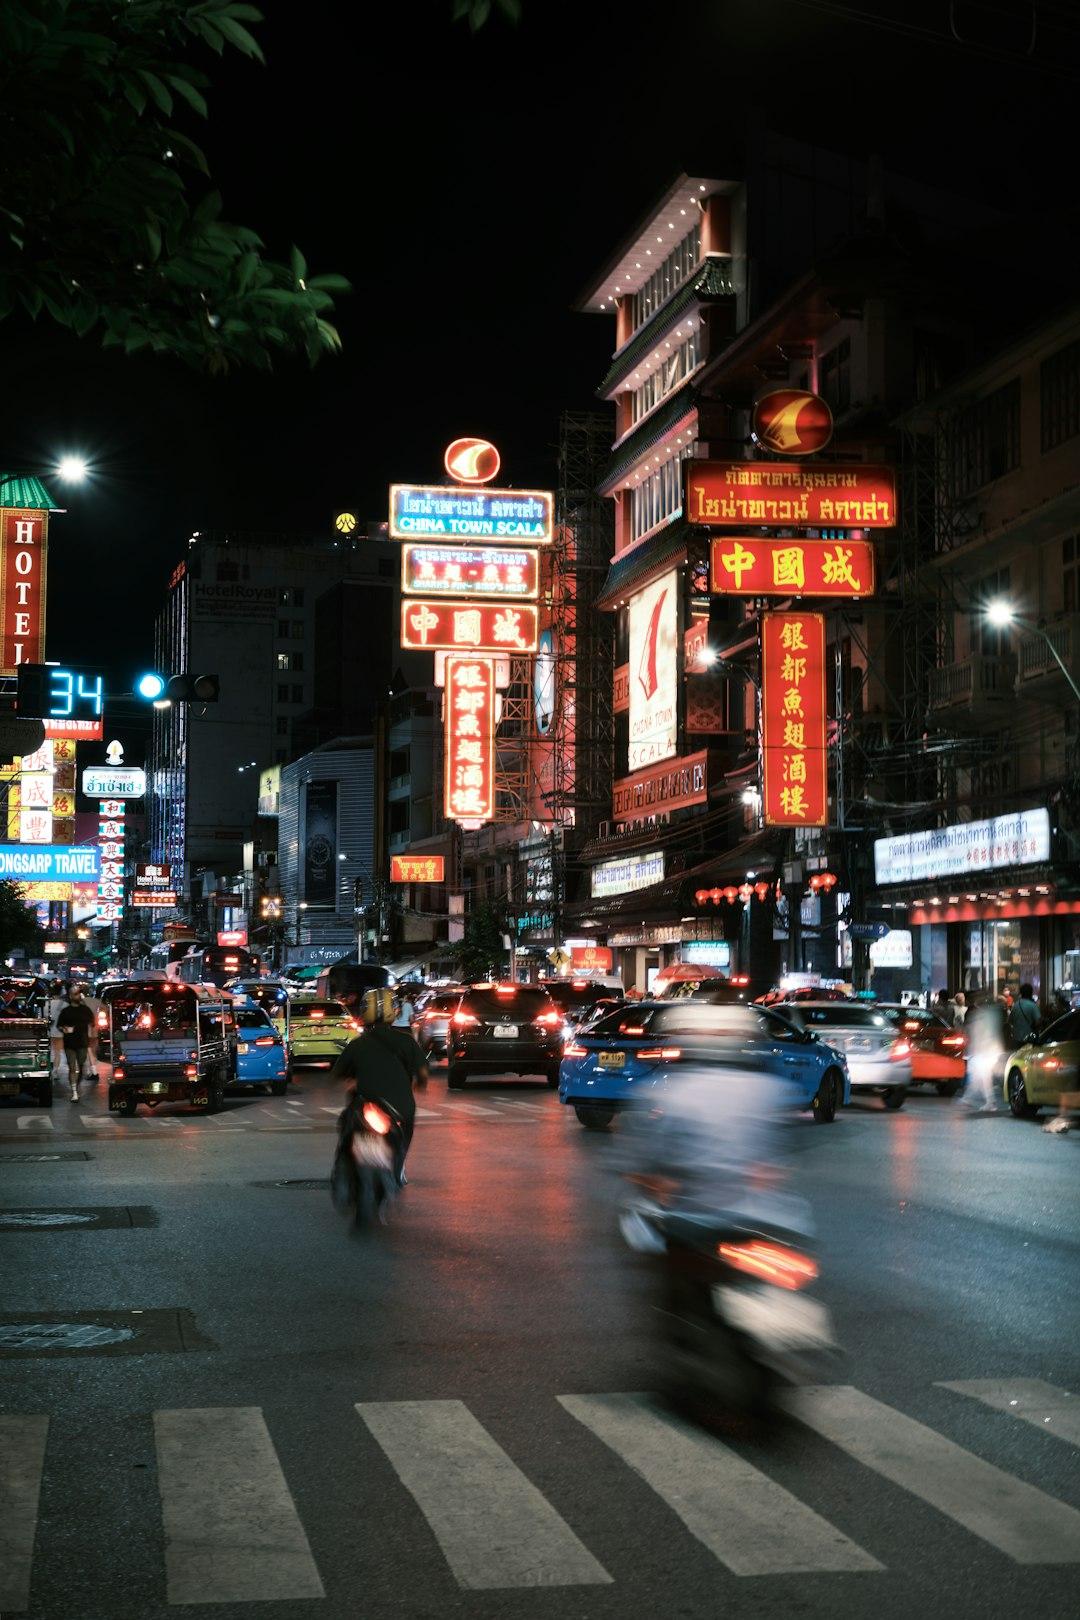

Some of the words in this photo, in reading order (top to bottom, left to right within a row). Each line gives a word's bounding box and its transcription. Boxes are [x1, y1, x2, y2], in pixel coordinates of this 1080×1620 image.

[695, 487, 810, 518] ไชน่าทาวน์
[820, 493, 889, 521] สกาล่า
[399, 517, 446, 532] CHINA
[449, 519, 494, 535] TOWN
[496, 521, 544, 537] SCALA
[721, 542, 861, 591] 中國城
[14, 521, 35, 665] HOTEL
[410, 604, 526, 648] 中國城
[51, 672, 102, 715] 34
[779, 622, 809, 818] 銀都魚翅酒樓
[632, 738, 673, 766] SCALA
[55, 854, 98, 874] TRAVEL
[105, 802, 119, 917] 和成興大金行
